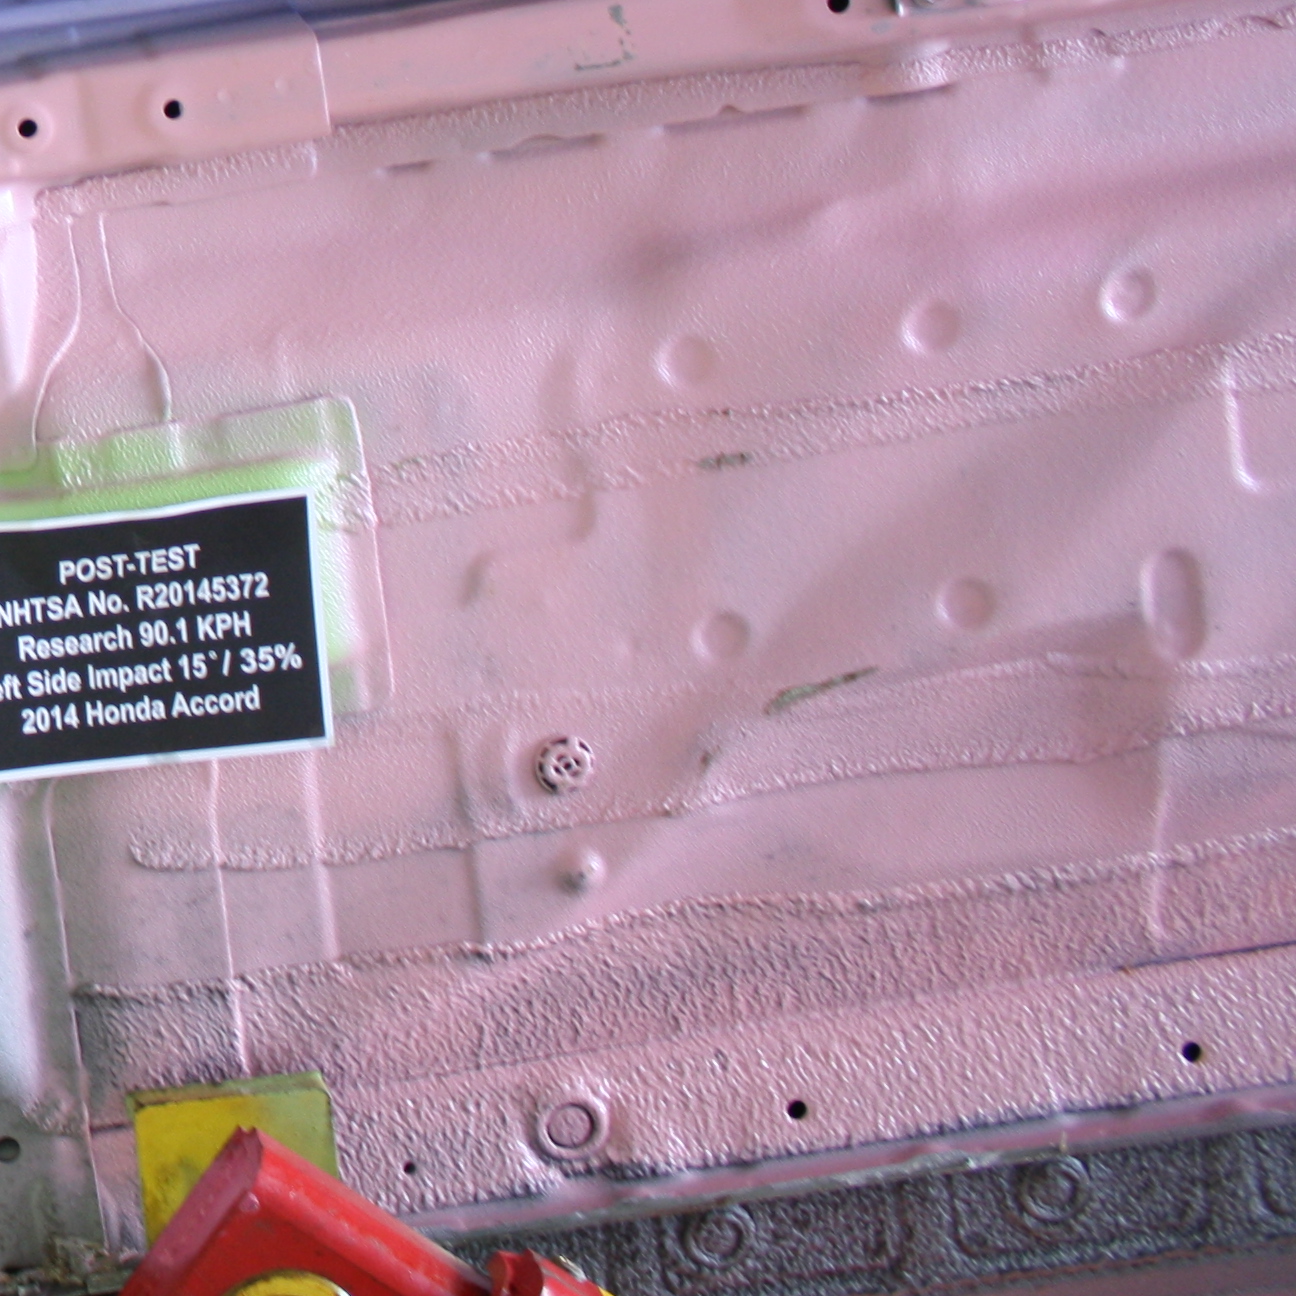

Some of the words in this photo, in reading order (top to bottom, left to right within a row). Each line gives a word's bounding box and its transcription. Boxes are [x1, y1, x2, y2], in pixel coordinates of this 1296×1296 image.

[58, 543, 201, 585] POST-TEST
[88, 590, 131, 616] No.
[136, 571, 271, 612] R20145372
[17, 624, 134, 662] Research
[139, 617, 189, 648] 90.1
[196, 610, 253, 641] KPH
[27, 667, 82, 697] Side
[87, 658, 174, 693] Impact
[240, 642, 303, 675] 35%
[21, 702, 81, 735] 2014
[85, 695, 168, 728] Honda
[171, 683, 262, 719] Accord
